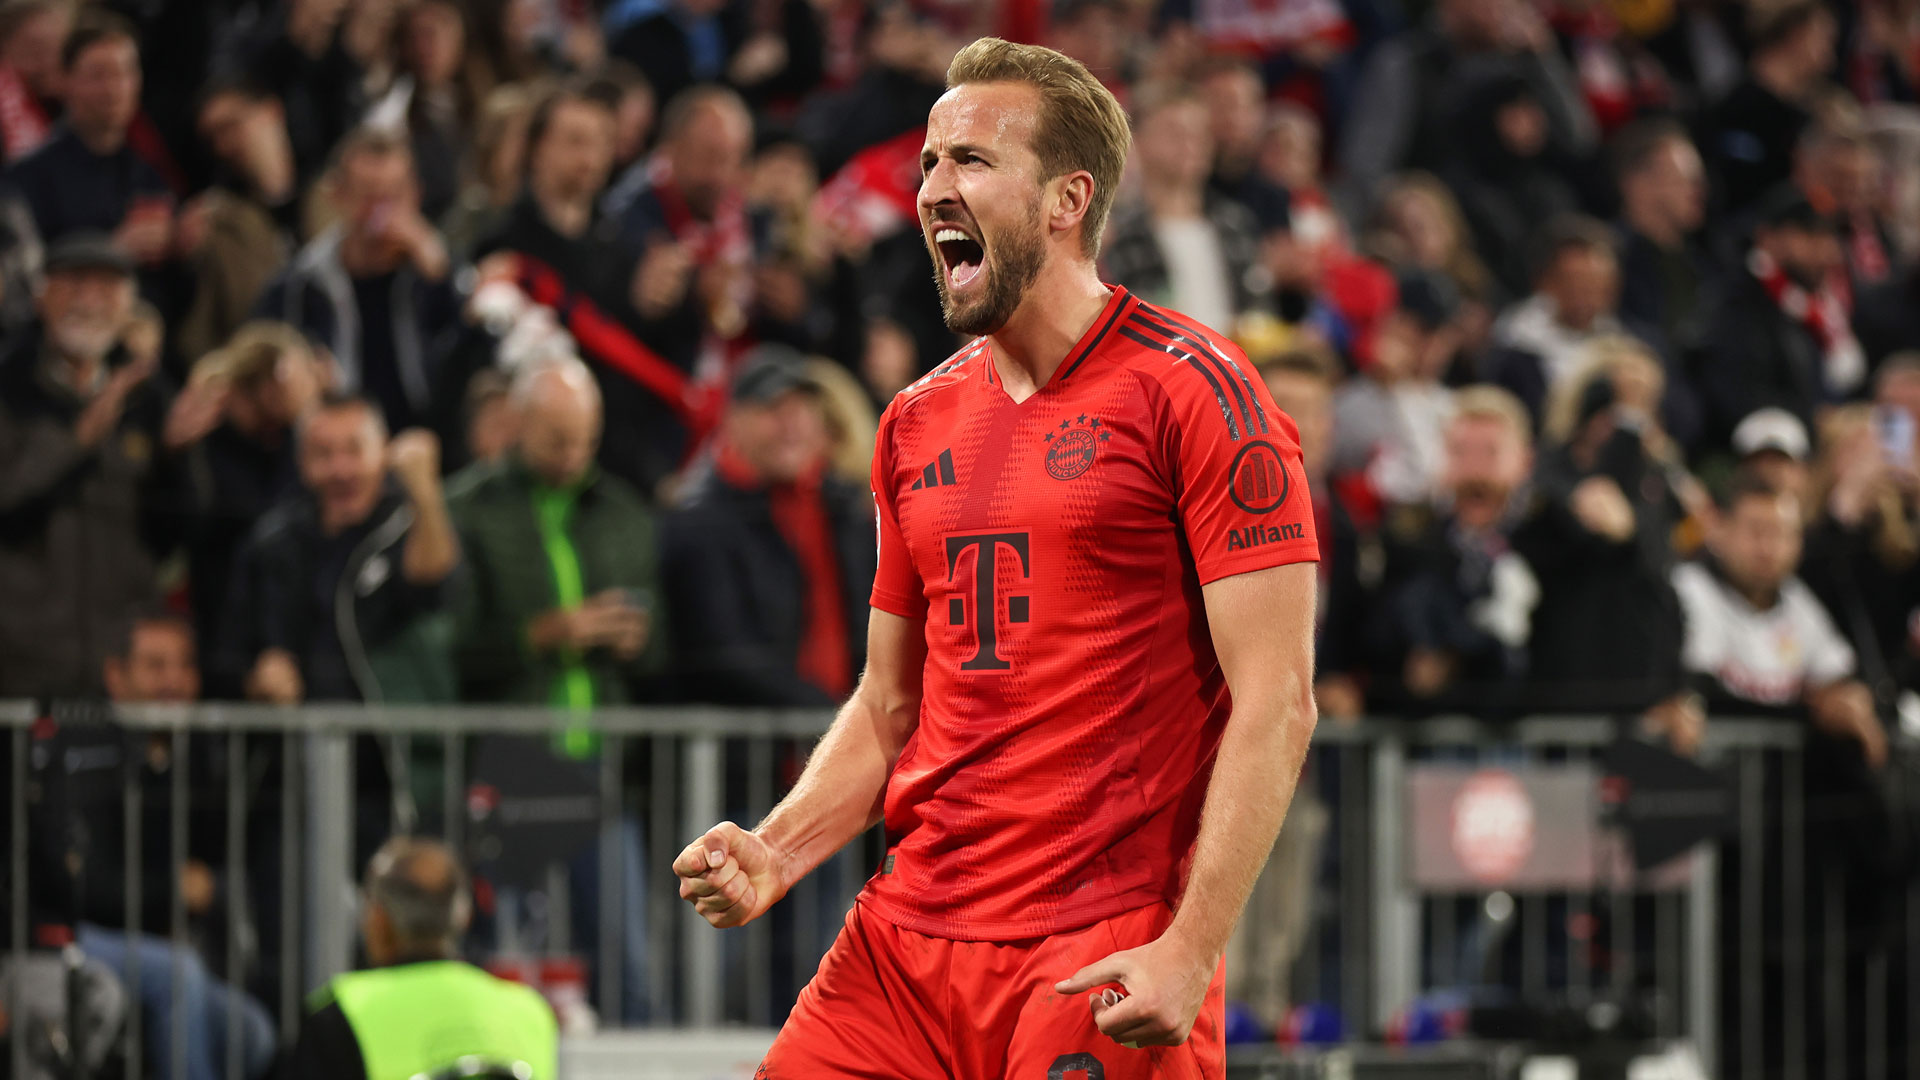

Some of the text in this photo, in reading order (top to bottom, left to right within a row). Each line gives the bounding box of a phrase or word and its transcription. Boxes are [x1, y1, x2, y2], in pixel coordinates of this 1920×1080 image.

[1065, 432, 1093, 450] BAYERN
[1228, 523, 1304, 552] Allianz
[946, 532, 1029, 670] T
